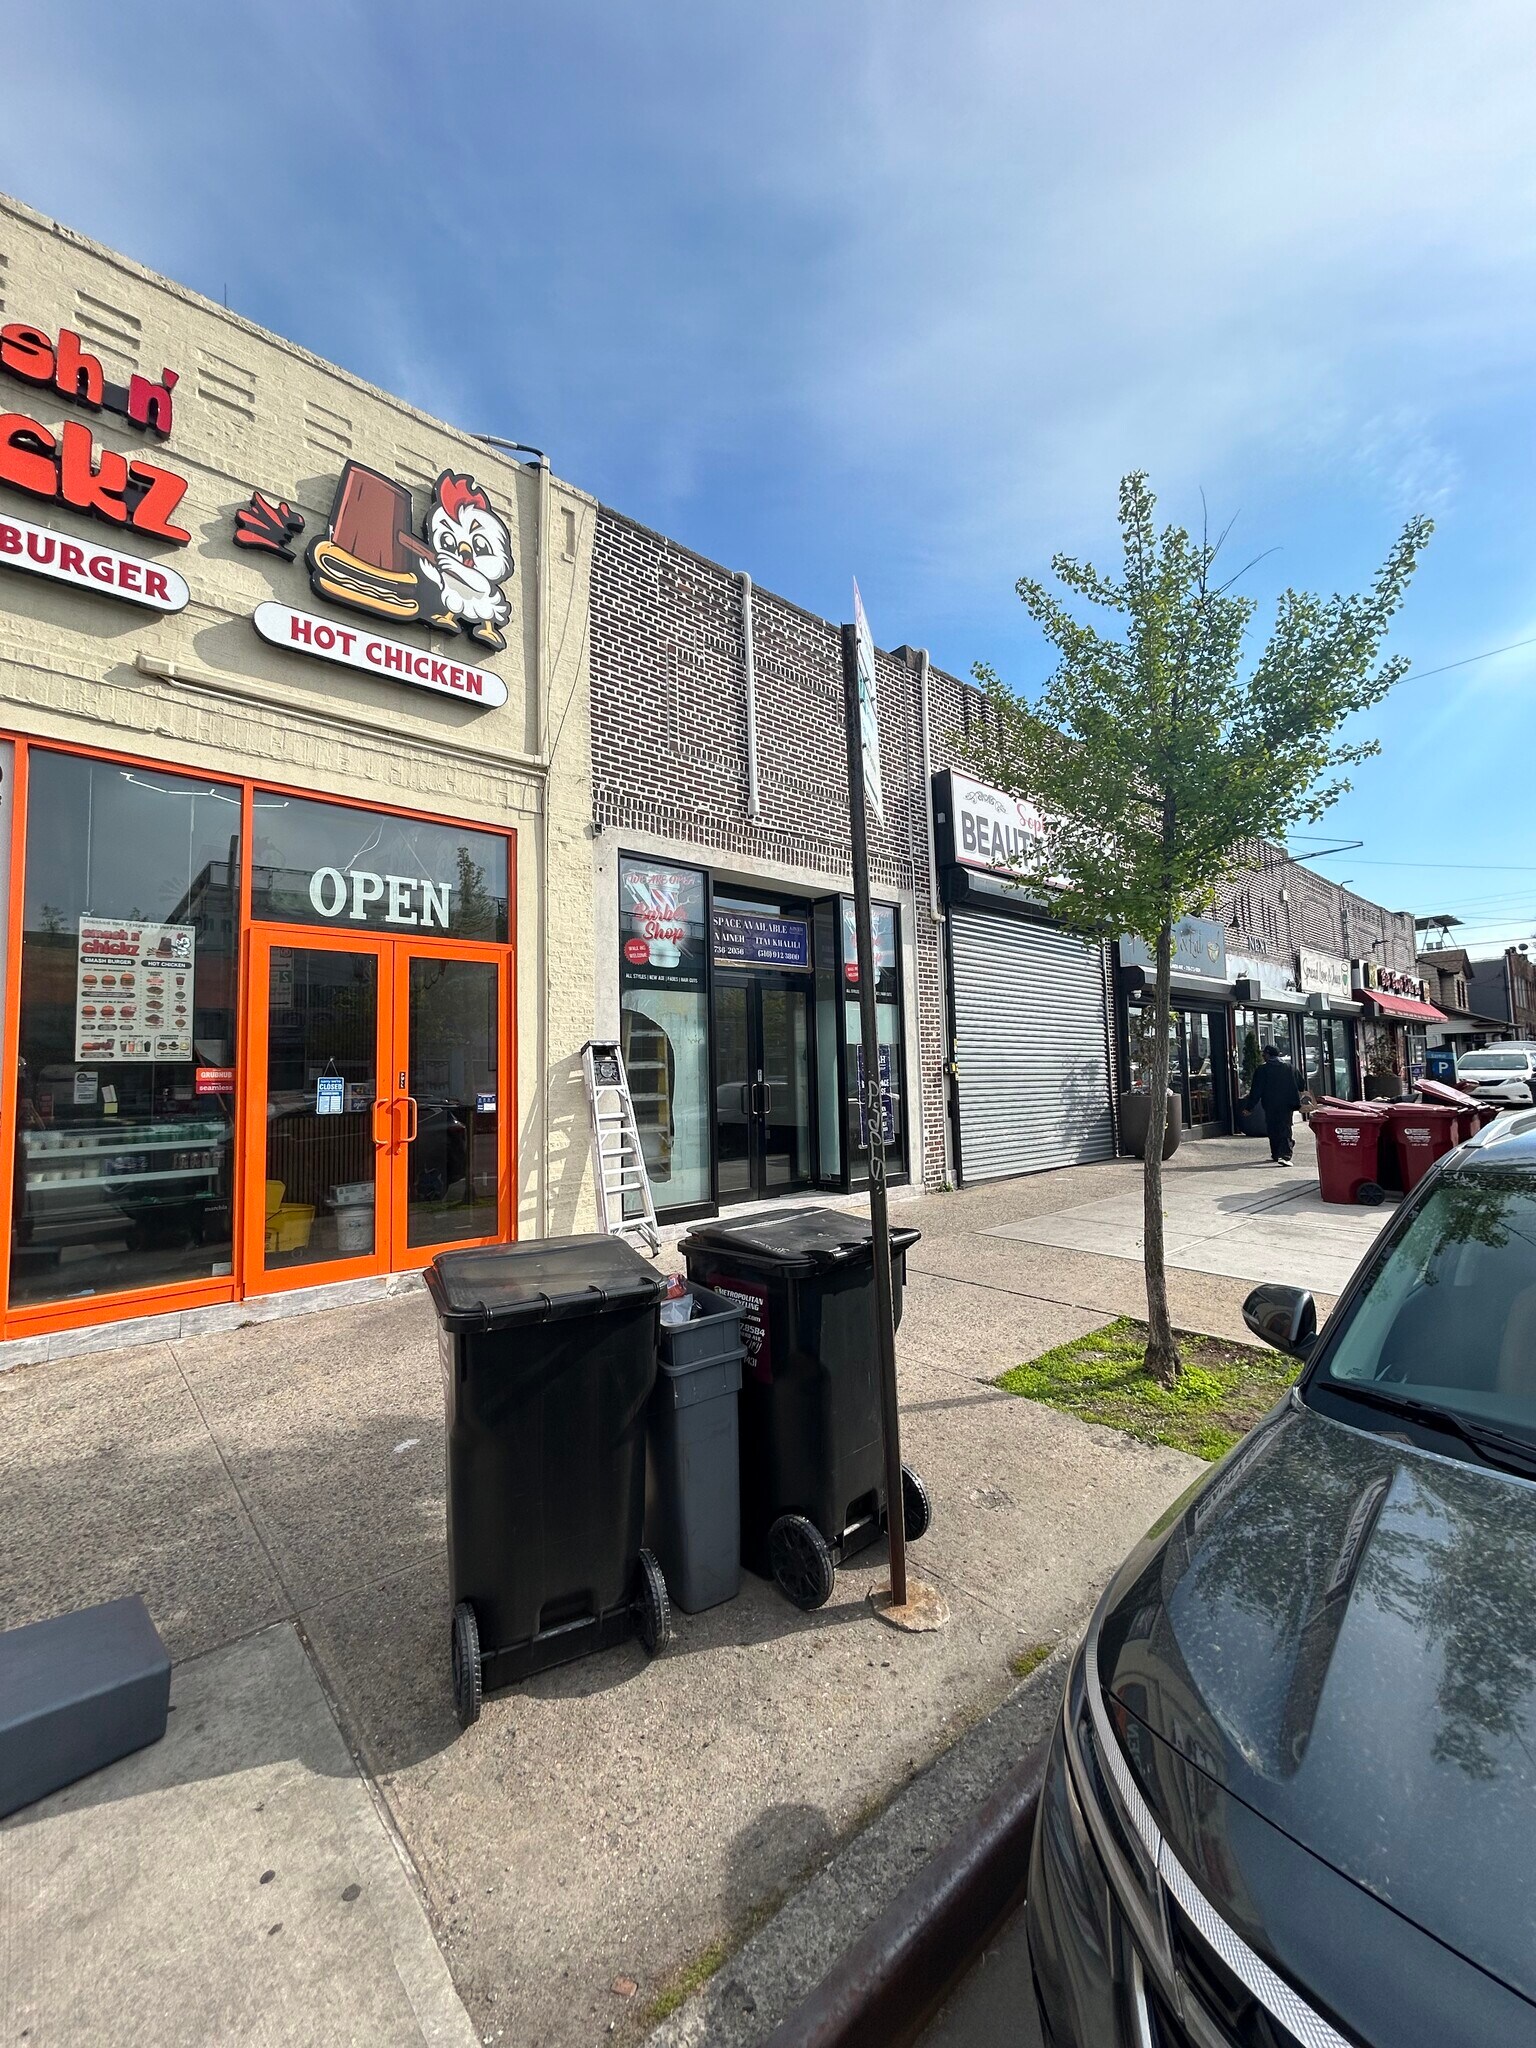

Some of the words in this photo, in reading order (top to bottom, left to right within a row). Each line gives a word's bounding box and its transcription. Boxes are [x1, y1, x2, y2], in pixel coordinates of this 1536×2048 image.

[0, 523, 172, 602] BURGER
[290, 615, 357, 656] HOT
[366, 642, 483, 696] CHICKEN
[309, 866, 452, 928] OPEN
[642, 921, 684, 945] Shop
[713, 916, 742, 929] SPACE
[743, 920, 788, 934] AVAILABLE
[722, 933, 745, 943] AINEH
[81, 939, 140, 957] chickz
[107, 958, 132, 966] BURGER
[200, 1071, 233, 1079] GRUBHUB
[718, 1287, 764, 1306] METROPOLITAN
